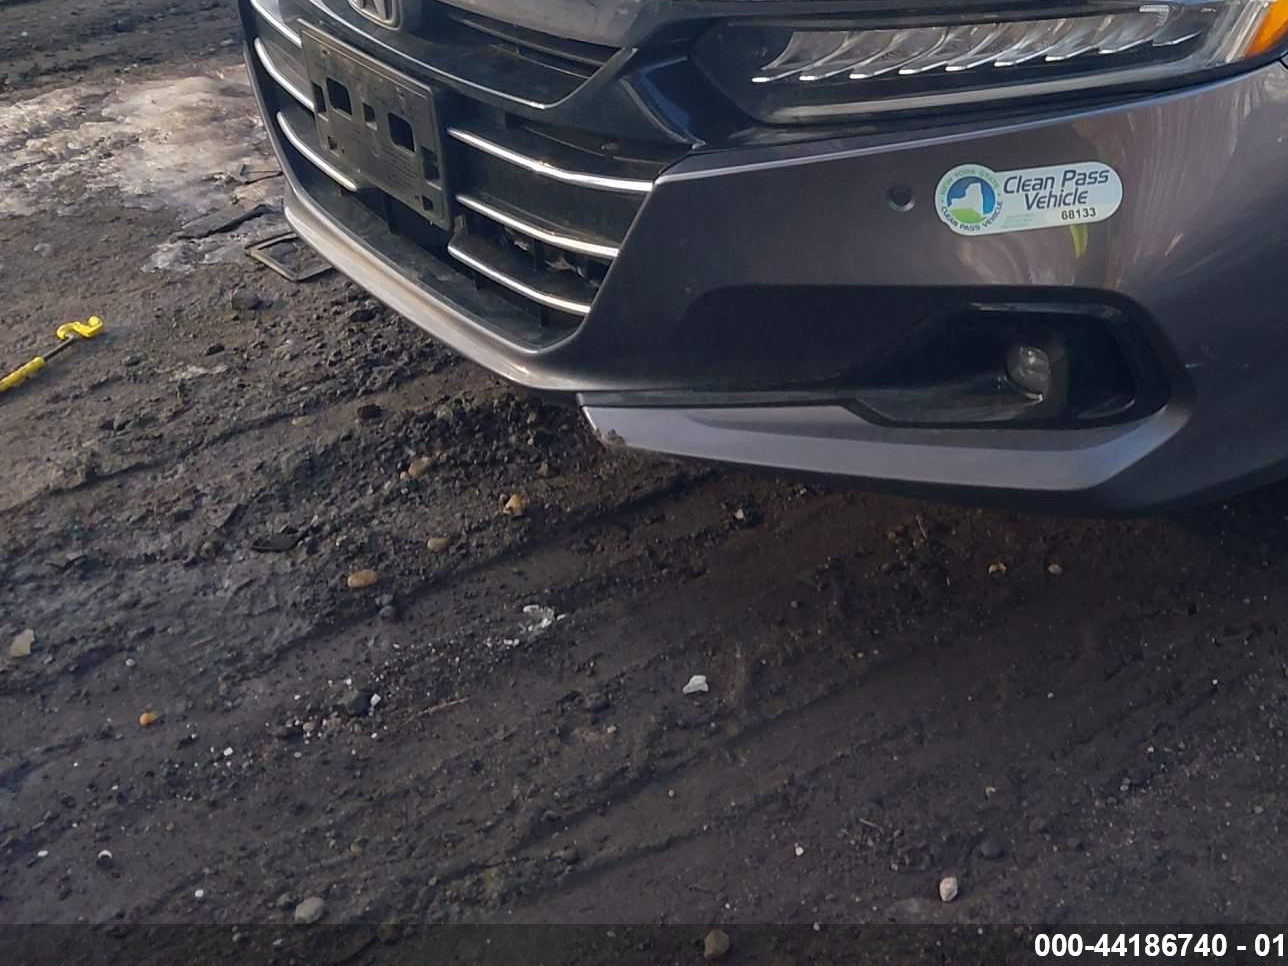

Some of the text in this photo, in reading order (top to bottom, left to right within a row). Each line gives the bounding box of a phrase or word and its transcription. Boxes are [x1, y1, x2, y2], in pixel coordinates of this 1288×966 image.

[1003, 169, 1110, 194] Clean Pass
[1024, 188, 1088, 210] Vehicle
[1061, 207, 1097, 221] 68133
